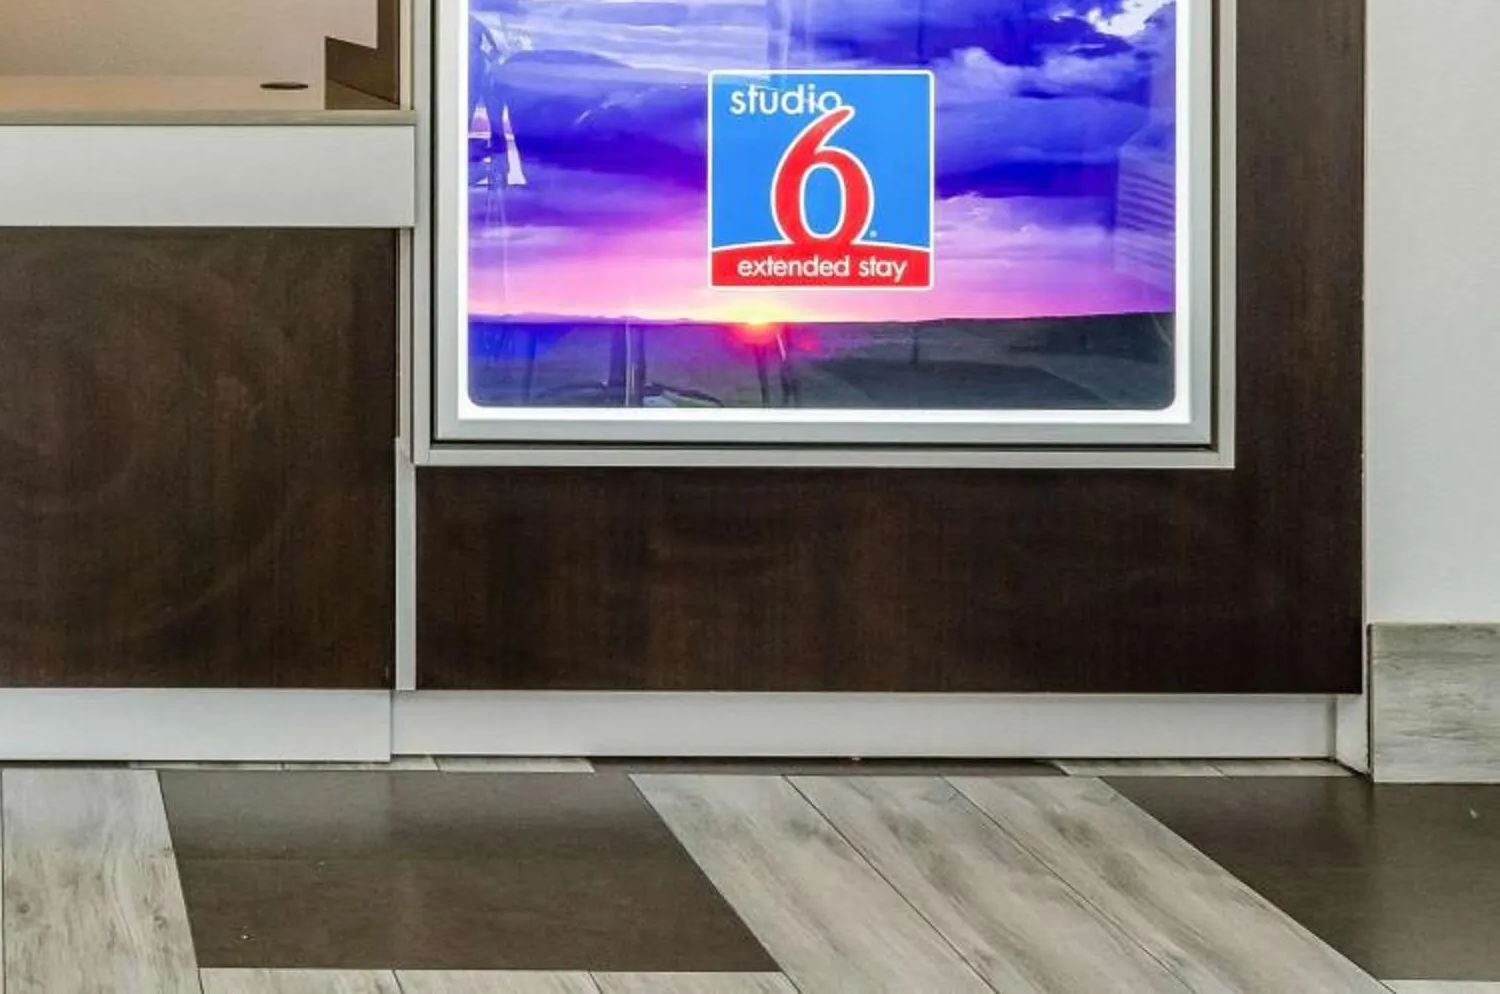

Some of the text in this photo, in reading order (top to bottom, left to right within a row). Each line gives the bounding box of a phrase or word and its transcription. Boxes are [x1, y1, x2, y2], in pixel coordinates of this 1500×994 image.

[729, 83, 843, 115] studio
[770, 105, 874, 247] 6
[737, 254, 908, 283] extended stay
